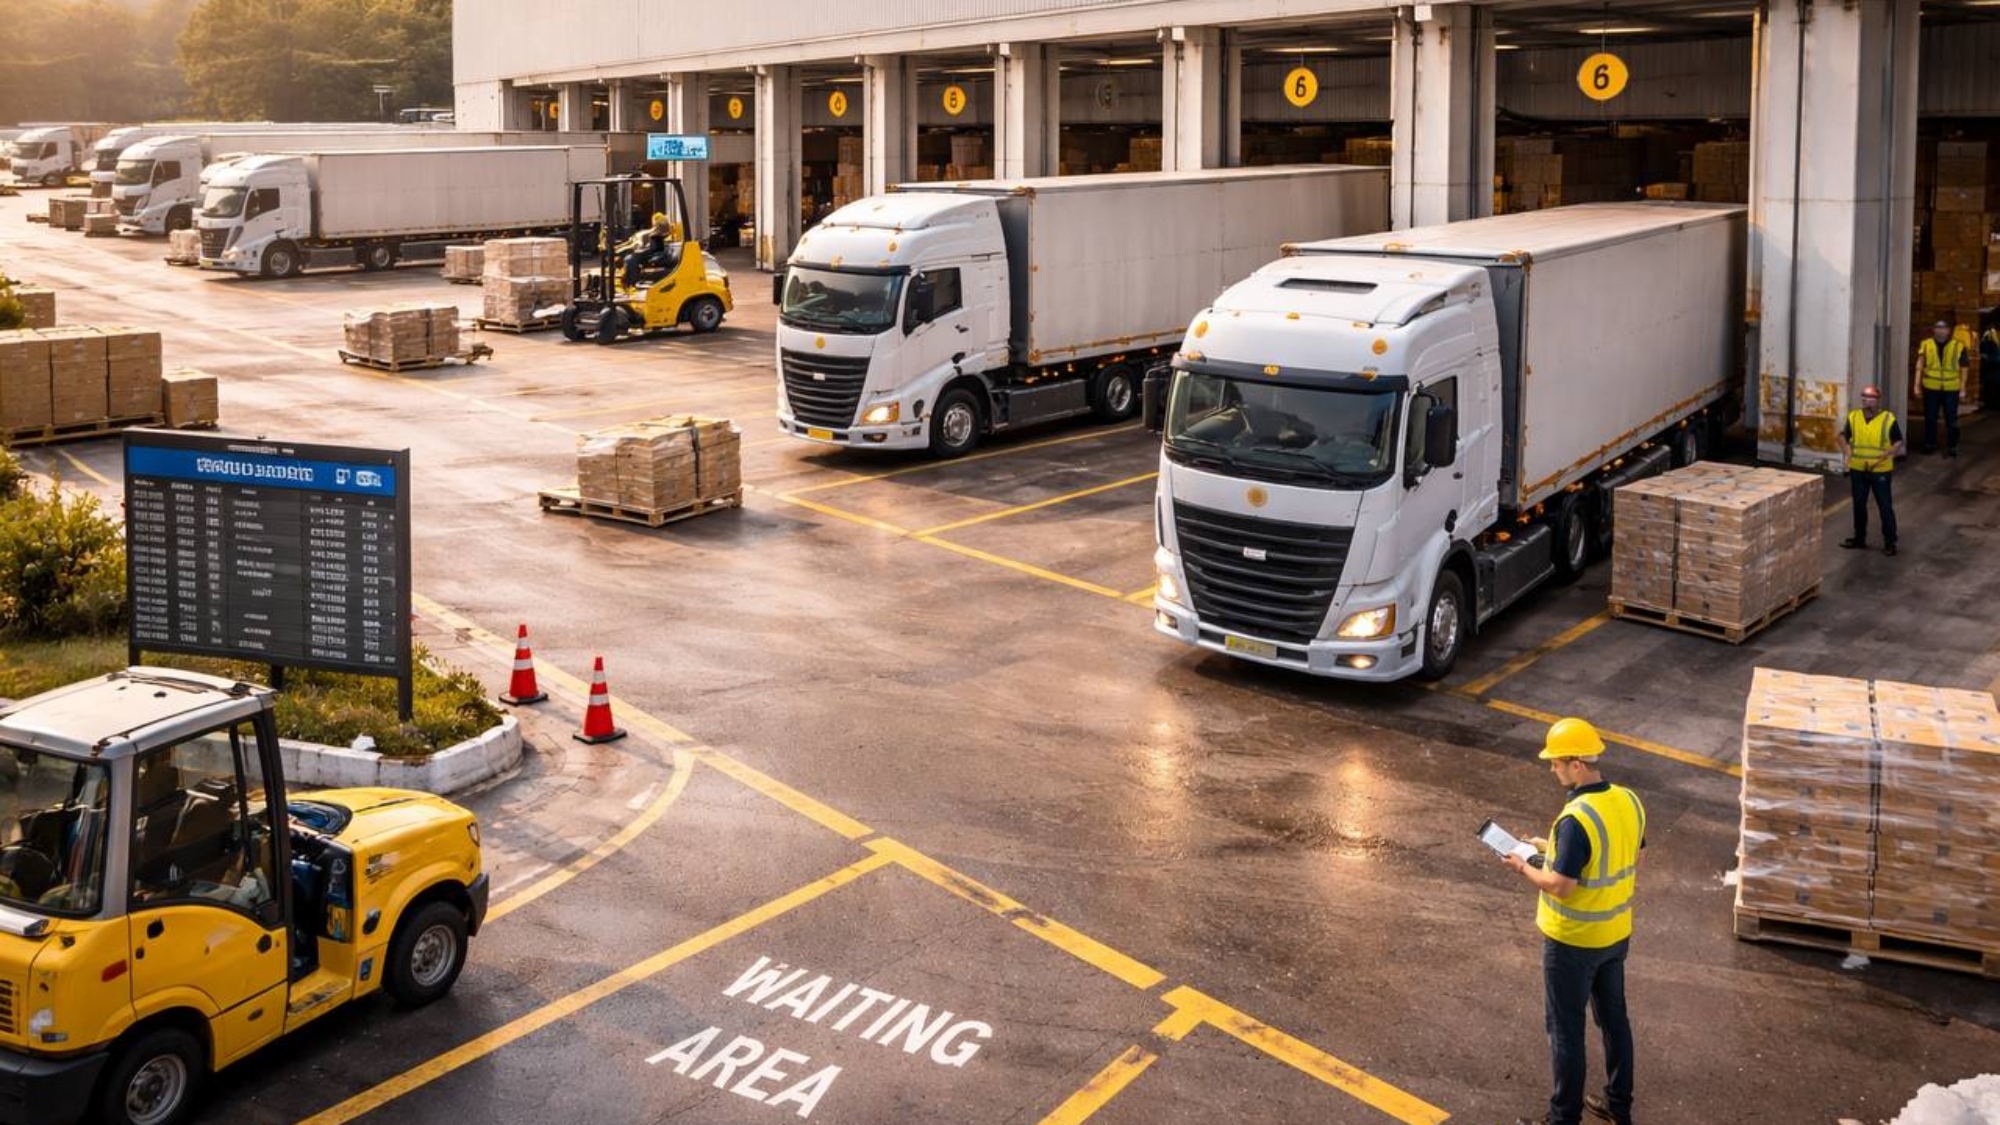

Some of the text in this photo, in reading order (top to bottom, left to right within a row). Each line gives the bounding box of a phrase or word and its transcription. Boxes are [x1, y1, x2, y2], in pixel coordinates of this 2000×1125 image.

[1295, 76, 1306, 98] 6
[1594, 64, 1609, 90] 6
[722, 955, 993, 1067] WAITING
[644, 1026, 843, 1118] AREA
